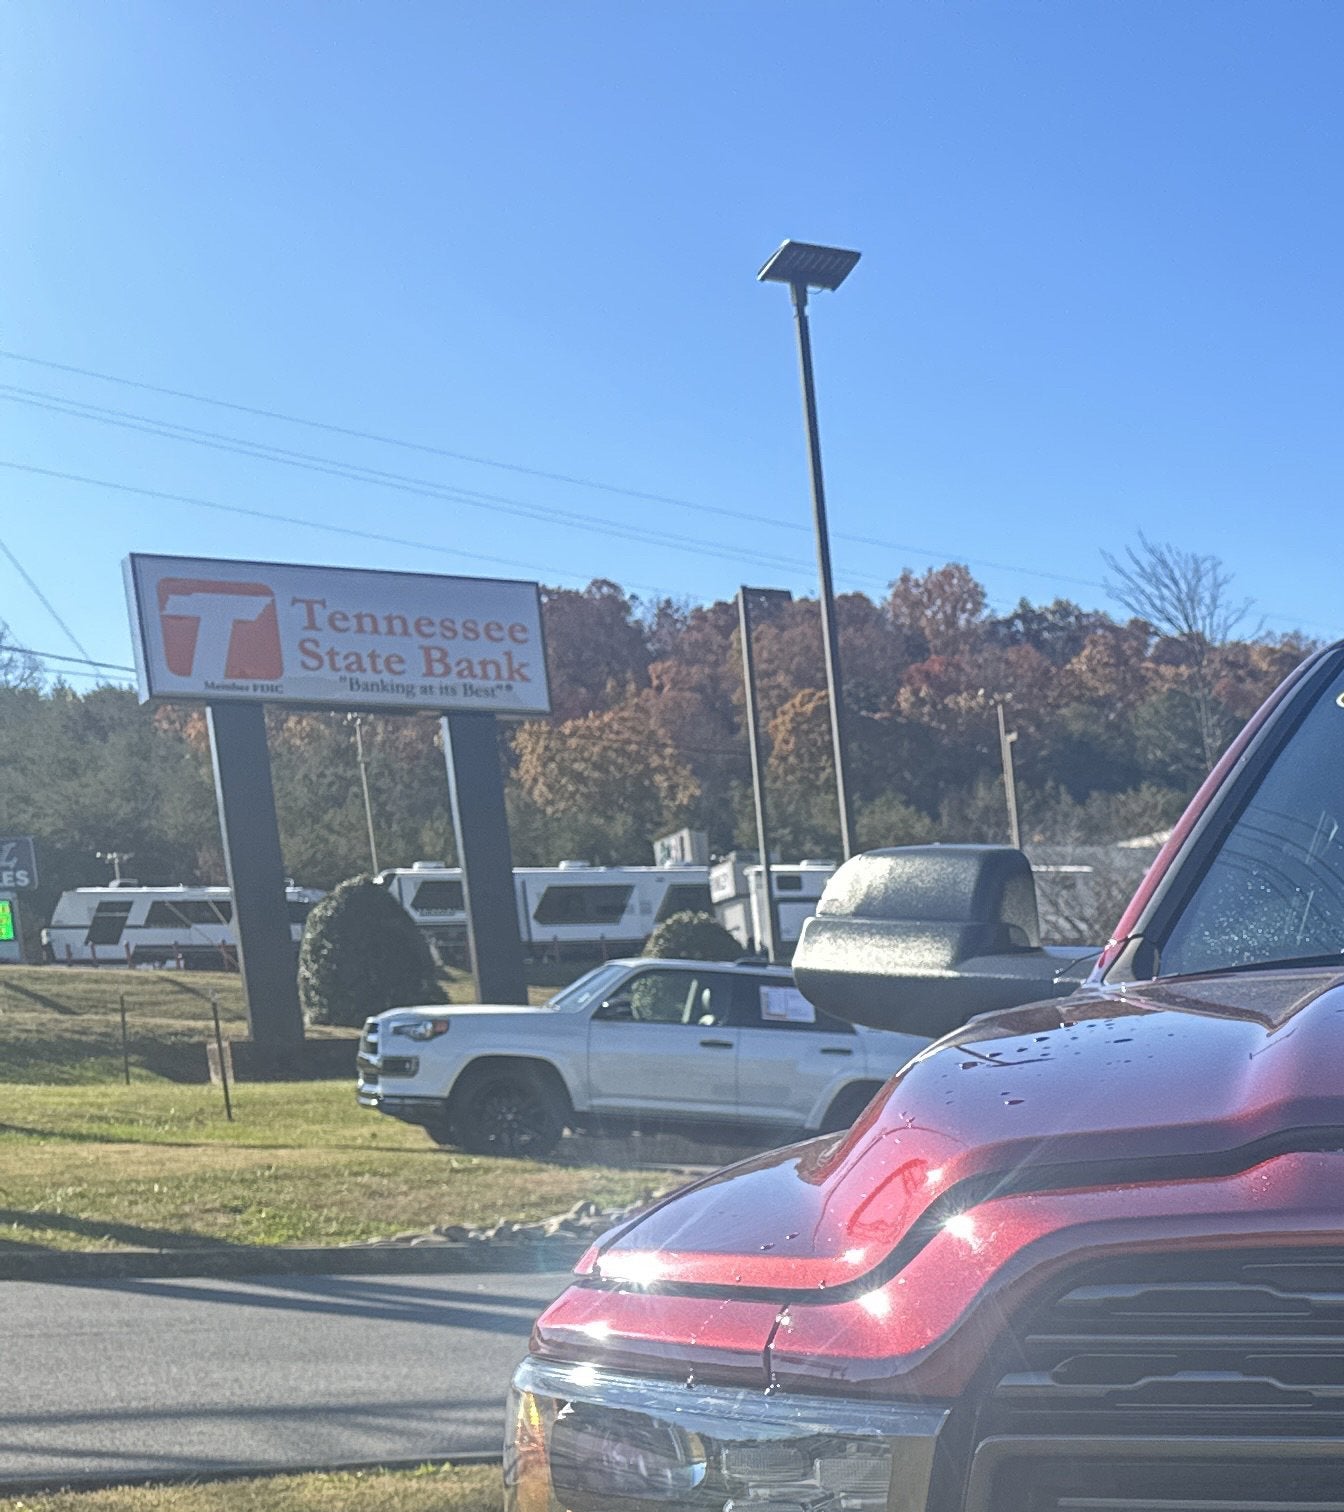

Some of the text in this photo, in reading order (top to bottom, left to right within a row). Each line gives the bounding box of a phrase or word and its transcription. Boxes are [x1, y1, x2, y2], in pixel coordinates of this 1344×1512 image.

[291, 596, 529, 645] Tennessee
[298, 637, 531, 682] State Bank
[419, 684, 434, 696] at
[439, 680, 457, 697] its
